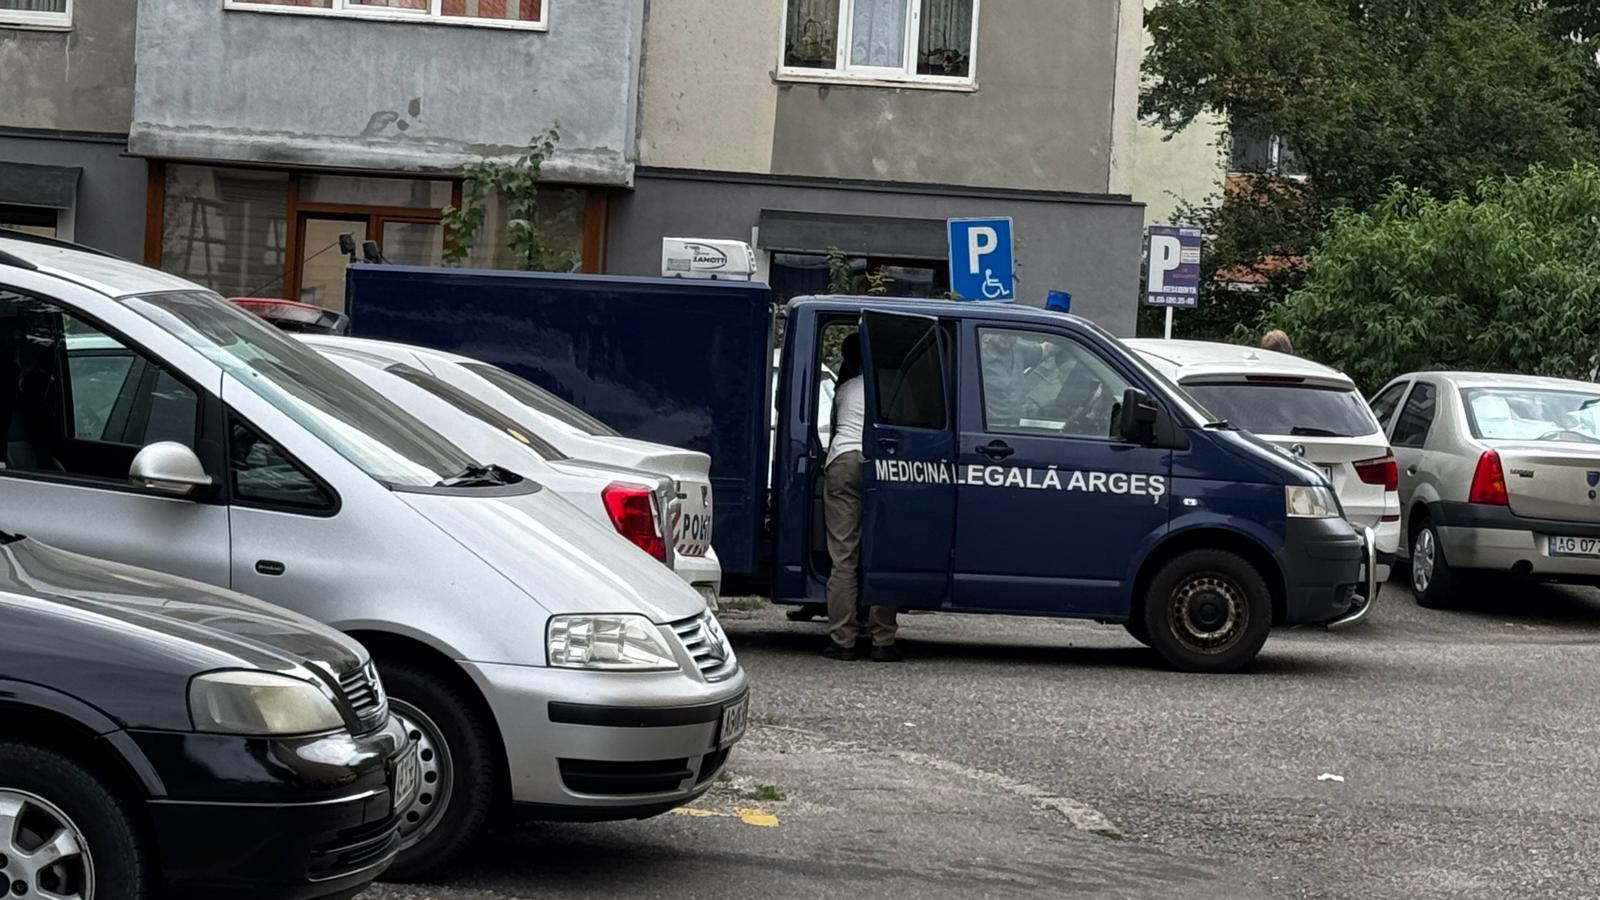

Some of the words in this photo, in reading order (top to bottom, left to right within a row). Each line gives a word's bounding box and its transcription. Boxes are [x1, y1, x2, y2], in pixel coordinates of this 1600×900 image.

[967, 226, 998, 275] P
[1148, 235, 1181, 292] P
[1558, 538, 1576, 551] AG
[1580, 538, 1600, 552] 07
